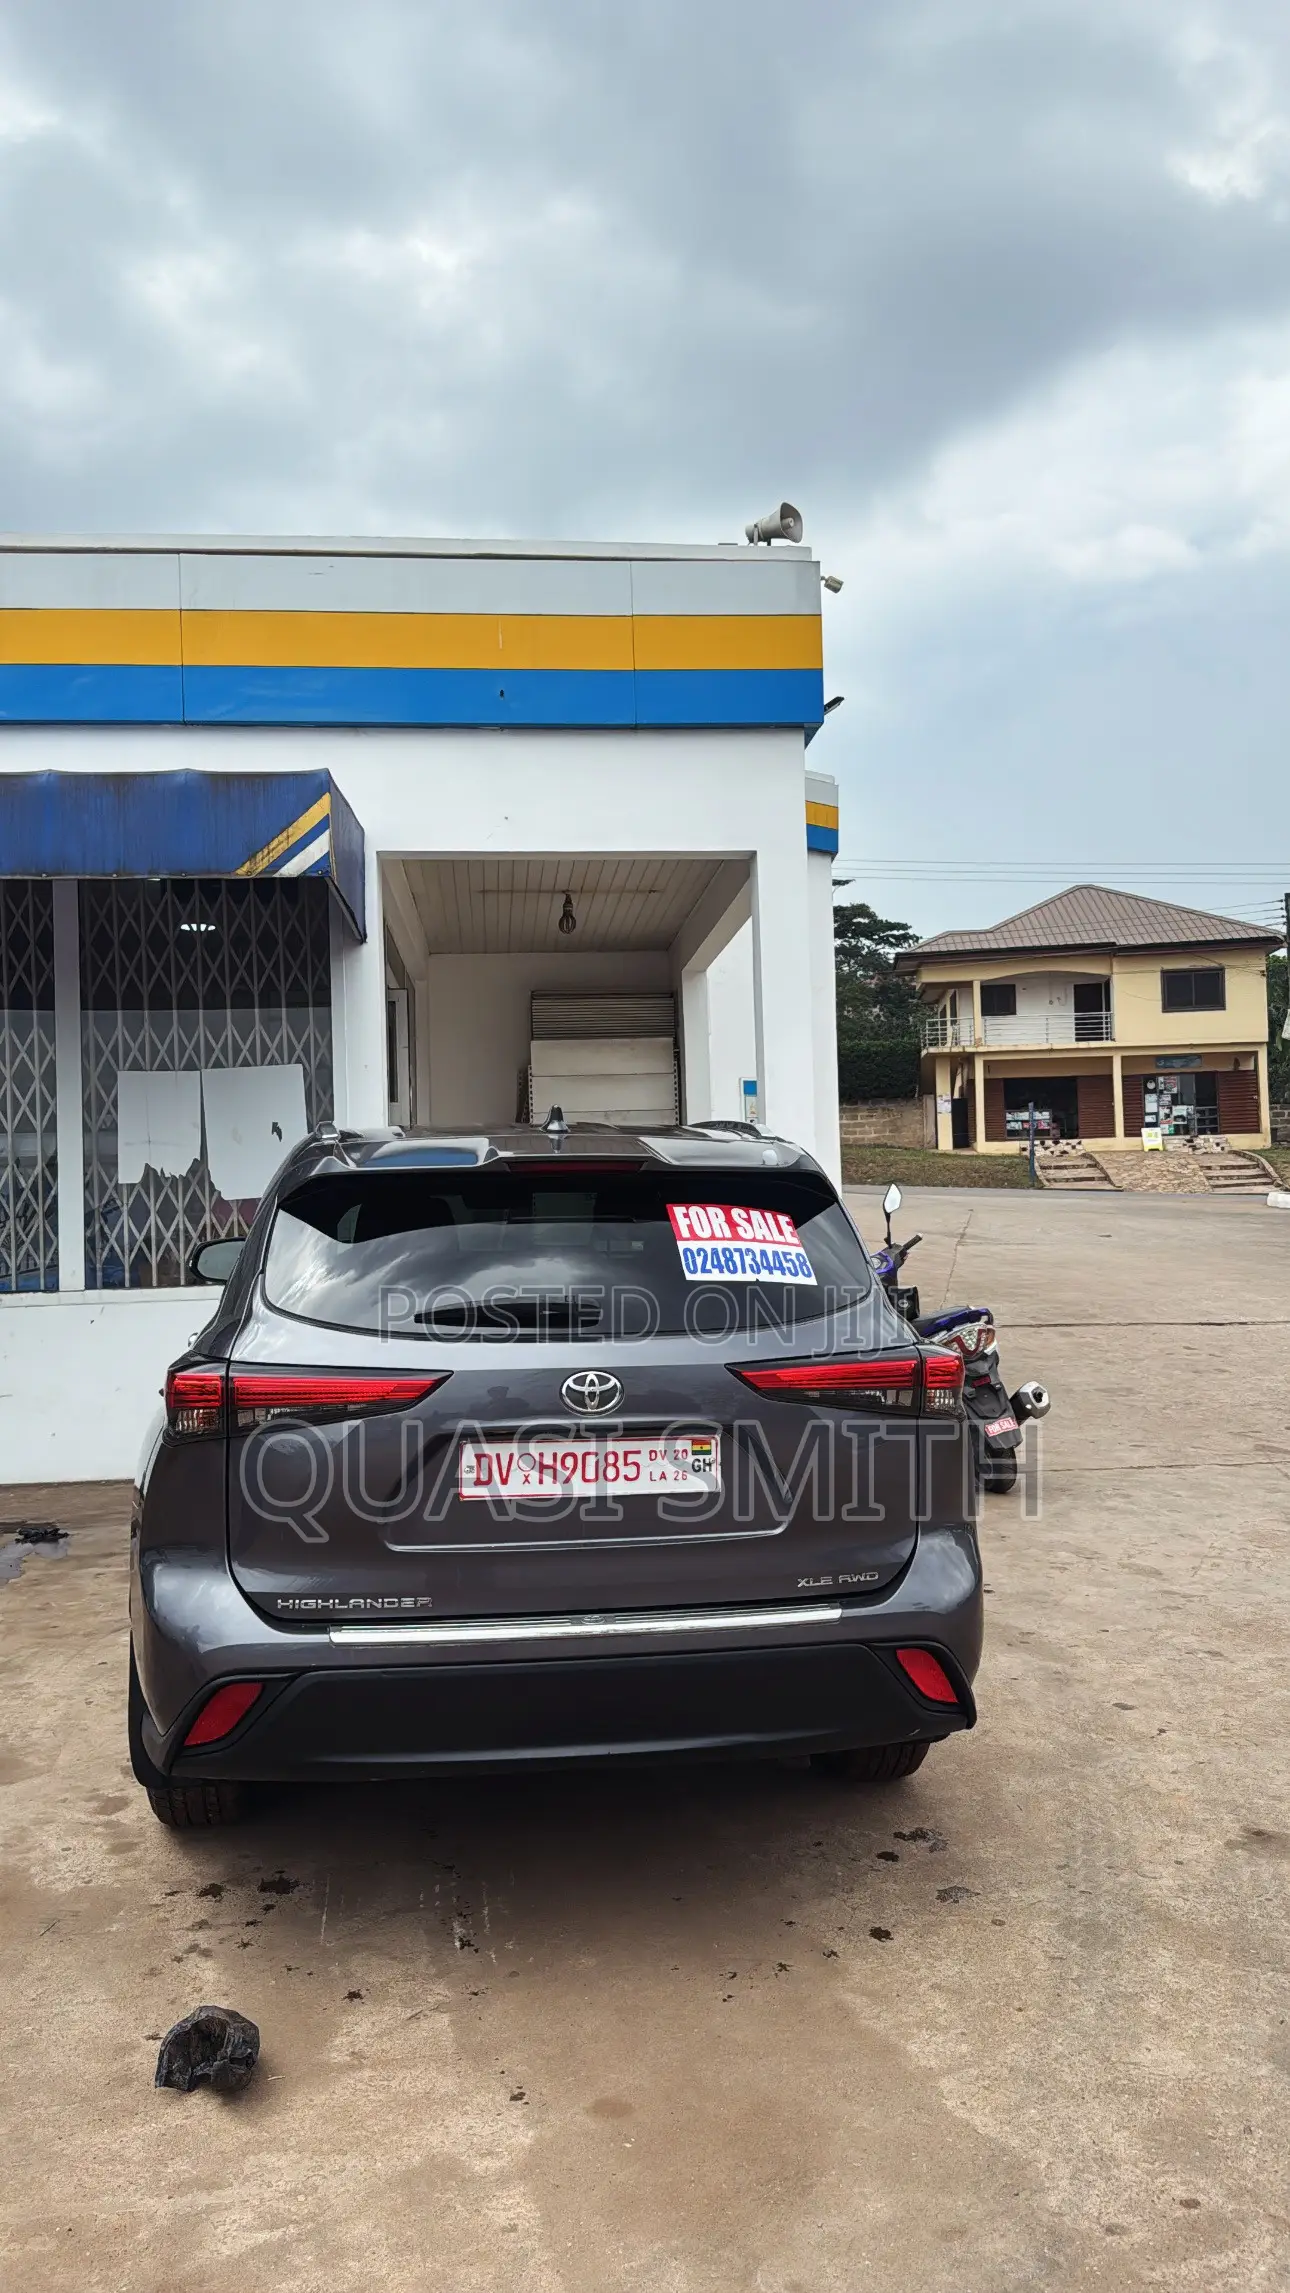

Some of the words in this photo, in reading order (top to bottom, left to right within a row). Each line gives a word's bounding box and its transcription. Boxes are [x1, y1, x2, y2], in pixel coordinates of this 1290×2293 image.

[673, 1206, 732, 1239] FOR
[731, 1208, 799, 1244] SALE
[682, 1247, 812, 1279] 0248734458
[649, 1449, 667, 1461] DV
[673, 1448, 688, 1461] 20
[474, 1453, 515, 1486] DV
[538, 1450, 642, 1485] H9085
[692, 1458, 712, 1473] GH
[650, 1471, 667, 1481] LA
[674, 1470, 687, 1481] 26
[797, 1576, 833, 1588] XLE
[277, 1597, 433, 1610] HIGHLANDER
